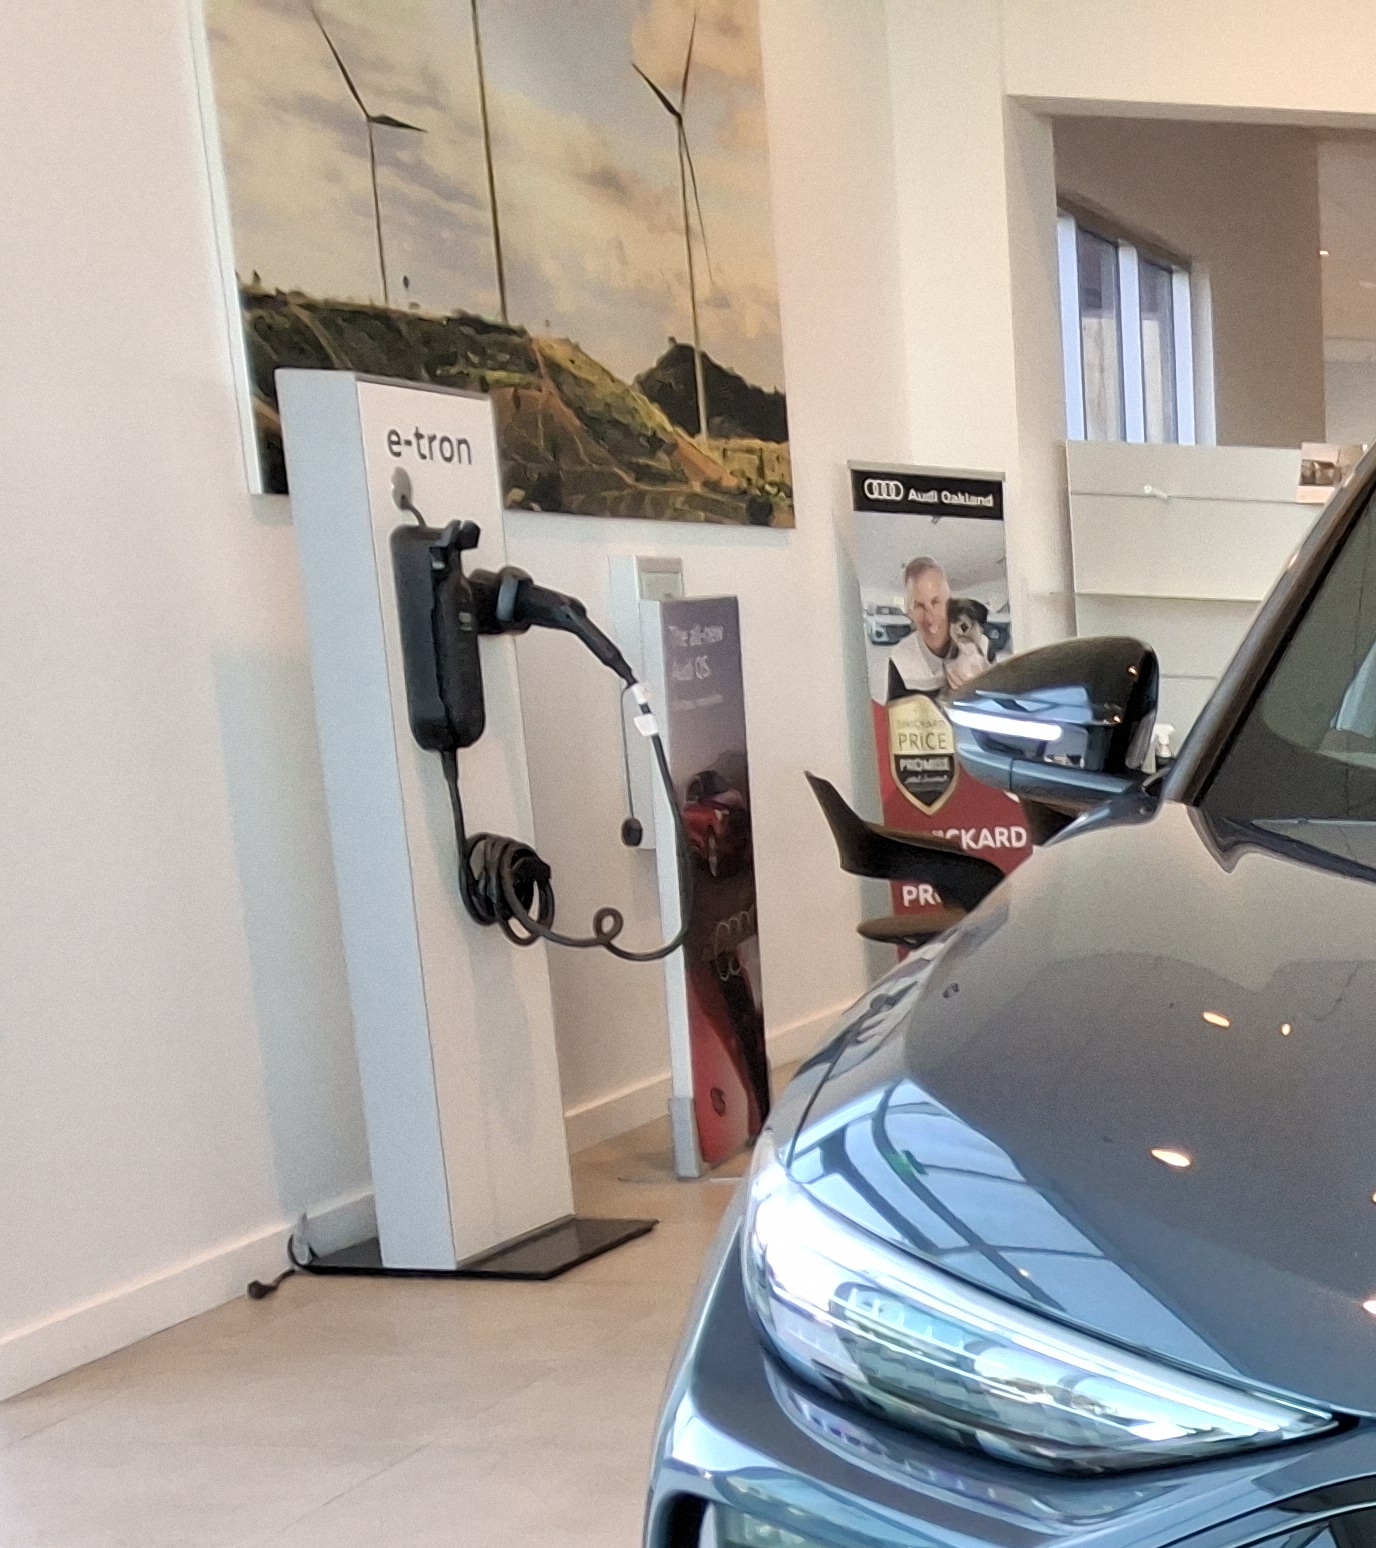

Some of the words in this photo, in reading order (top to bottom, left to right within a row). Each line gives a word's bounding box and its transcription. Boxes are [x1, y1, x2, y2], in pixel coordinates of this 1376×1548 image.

[387, 425, 472, 465] e-tron
[898, 732, 947, 751] PRICE
[931, 826, 1027, 850] KARD
